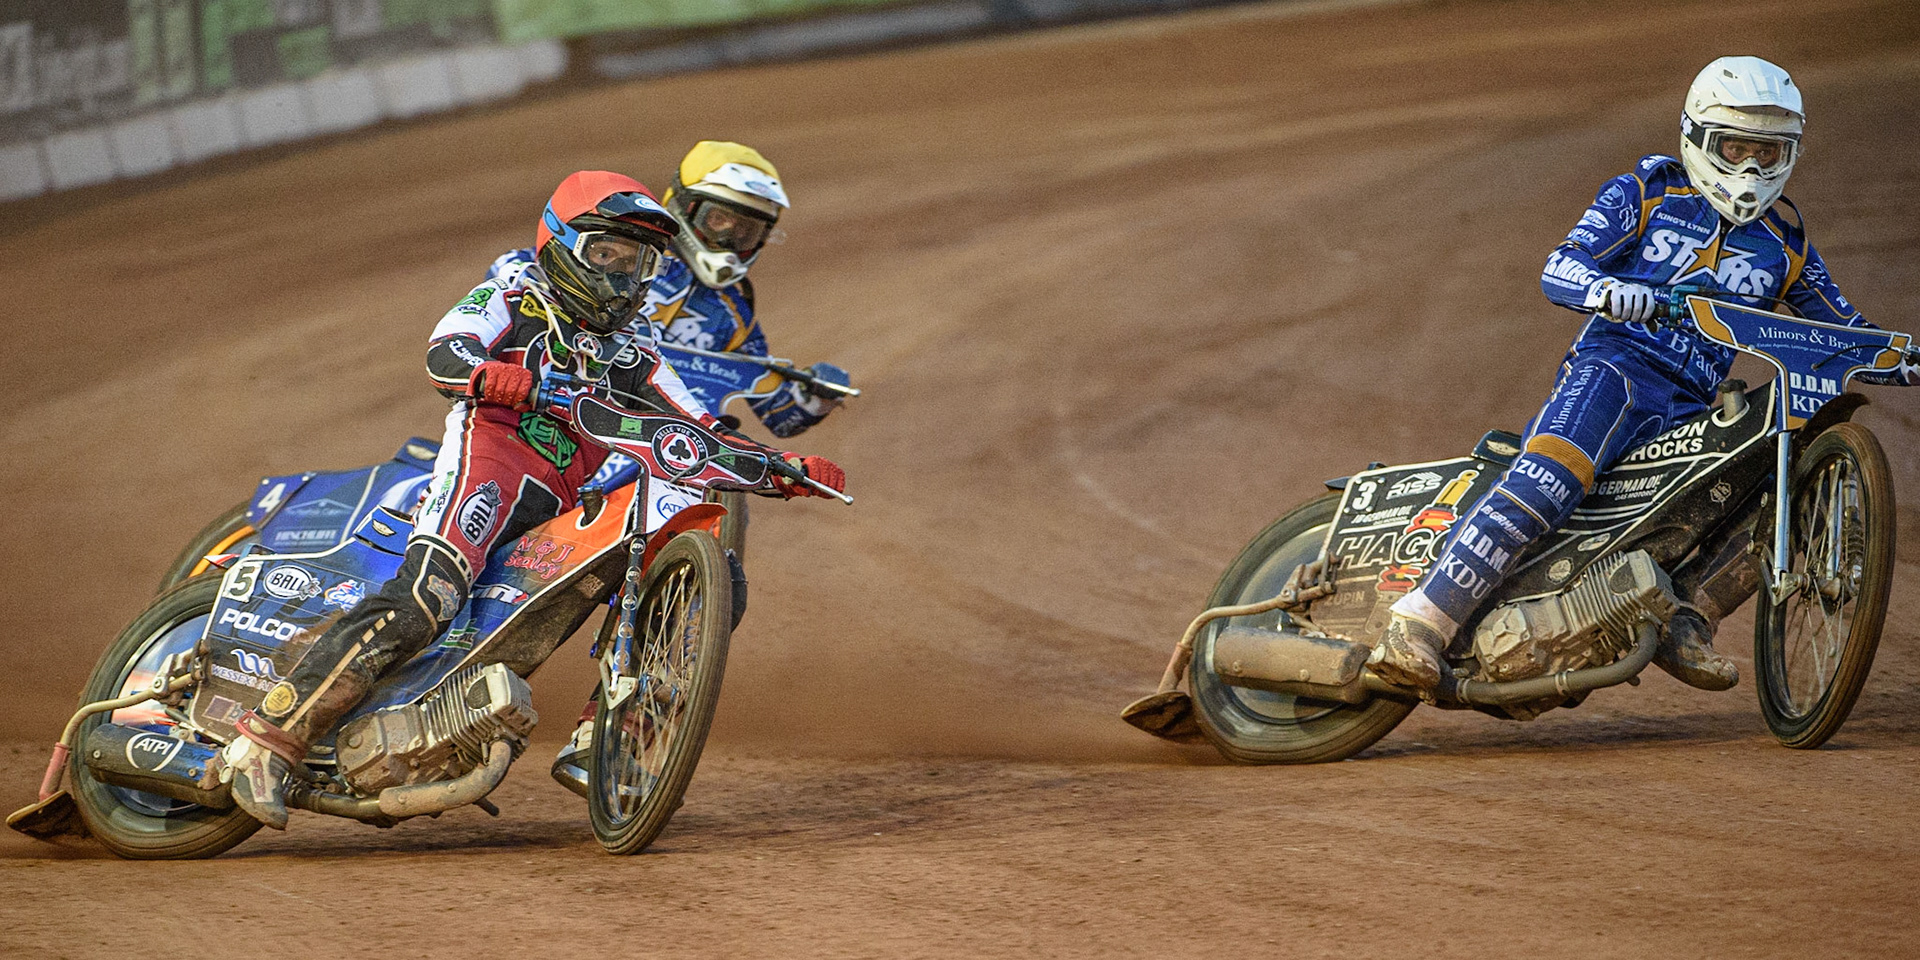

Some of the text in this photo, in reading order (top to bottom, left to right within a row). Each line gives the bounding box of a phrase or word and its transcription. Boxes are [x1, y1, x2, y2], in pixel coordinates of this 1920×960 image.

[1656, 211, 1711, 236] KING'S LYNN
[1567, 227, 1600, 244] UPIN
[1758, 327, 1807, 341] Minors
[1809, 329, 1825, 345] &
[1791, 393, 1830, 413] KD
[656, 426, 674, 441] BELLE
[676, 426, 691, 436] VUE
[1515, 459, 1571, 503] ZUPIN
[1598, 477, 1646, 495] GERMAN
[257, 483, 286, 512] 4
[1352, 481, 1377, 510] 3
[230, 566, 255, 597] 5
[1439, 552, 1491, 600] KDU
[134, 736, 173, 755] ATPI
